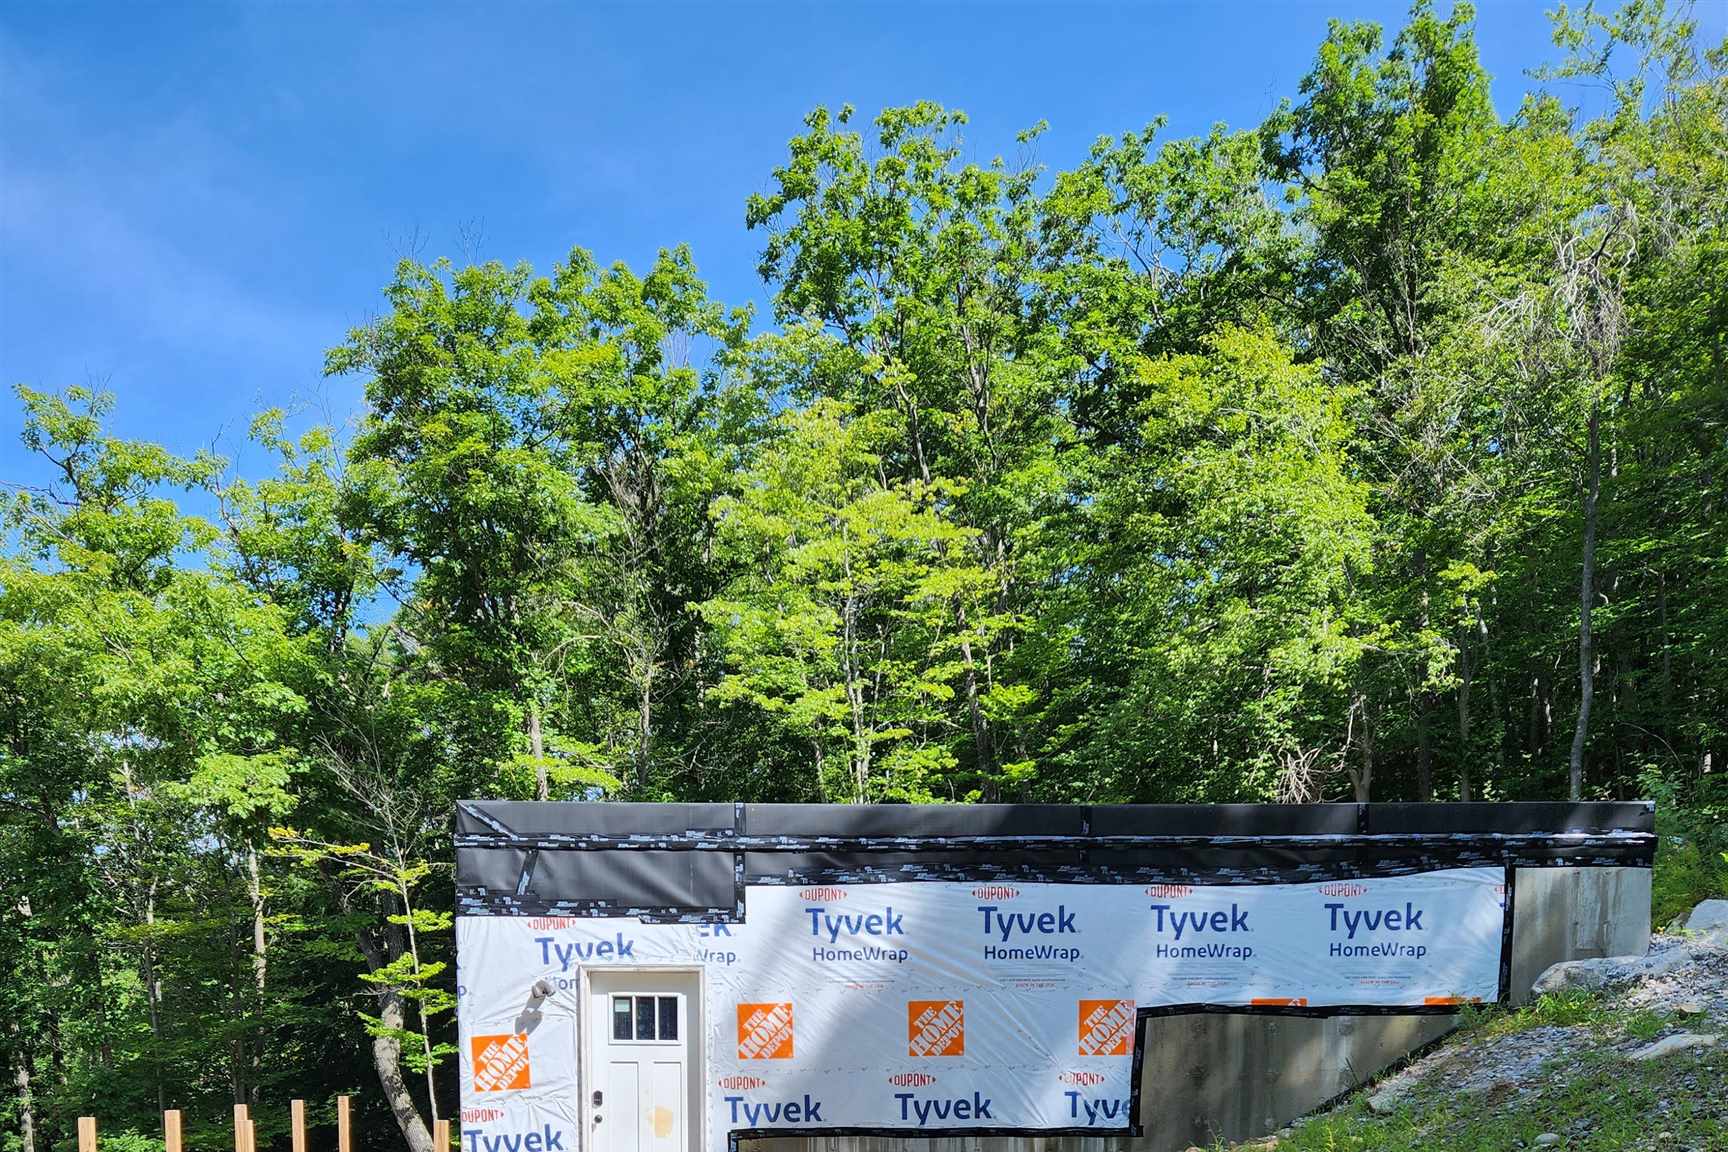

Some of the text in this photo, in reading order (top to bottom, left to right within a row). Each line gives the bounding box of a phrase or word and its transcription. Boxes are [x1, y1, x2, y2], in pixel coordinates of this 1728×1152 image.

[805, 887, 842, 902] DUPONT
[977, 886, 1015, 900] DUPONT
[1150, 885, 1188, 899] DUPONT
[1324, 883, 1362, 897] DUPONT
[533, 917, 571, 931] DUPONT
[805, 906, 904, 944] Tyvek
[977, 904, 1076, 942] Tyvek
[1150, 903, 1249, 941] Tyvek
[1324, 902, 1423, 939] Tyvek
[534, 932, 635, 972] Tyvek
[813, 947, 908, 963] HomeWrap
[984, 945, 1080, 962] HomeWrap
[1157, 943, 1253, 961] HomeWrap
[1330, 942, 1427, 959] HomeWrap
[738, 1003, 793, 1058] HOME
[910, 1001, 963, 1056] HOME
[1079, 1000, 1135, 1056] HOME
[474, 1029, 528, 1091] HOME
[724, 1076, 761, 1090] DUPONT
[894, 1073, 931, 1087] DUPONT
[462, 1108, 499, 1123] DUPONT
[724, 1094, 823, 1127] Tyvek
[894, 1091, 992, 1126] Tyvek
